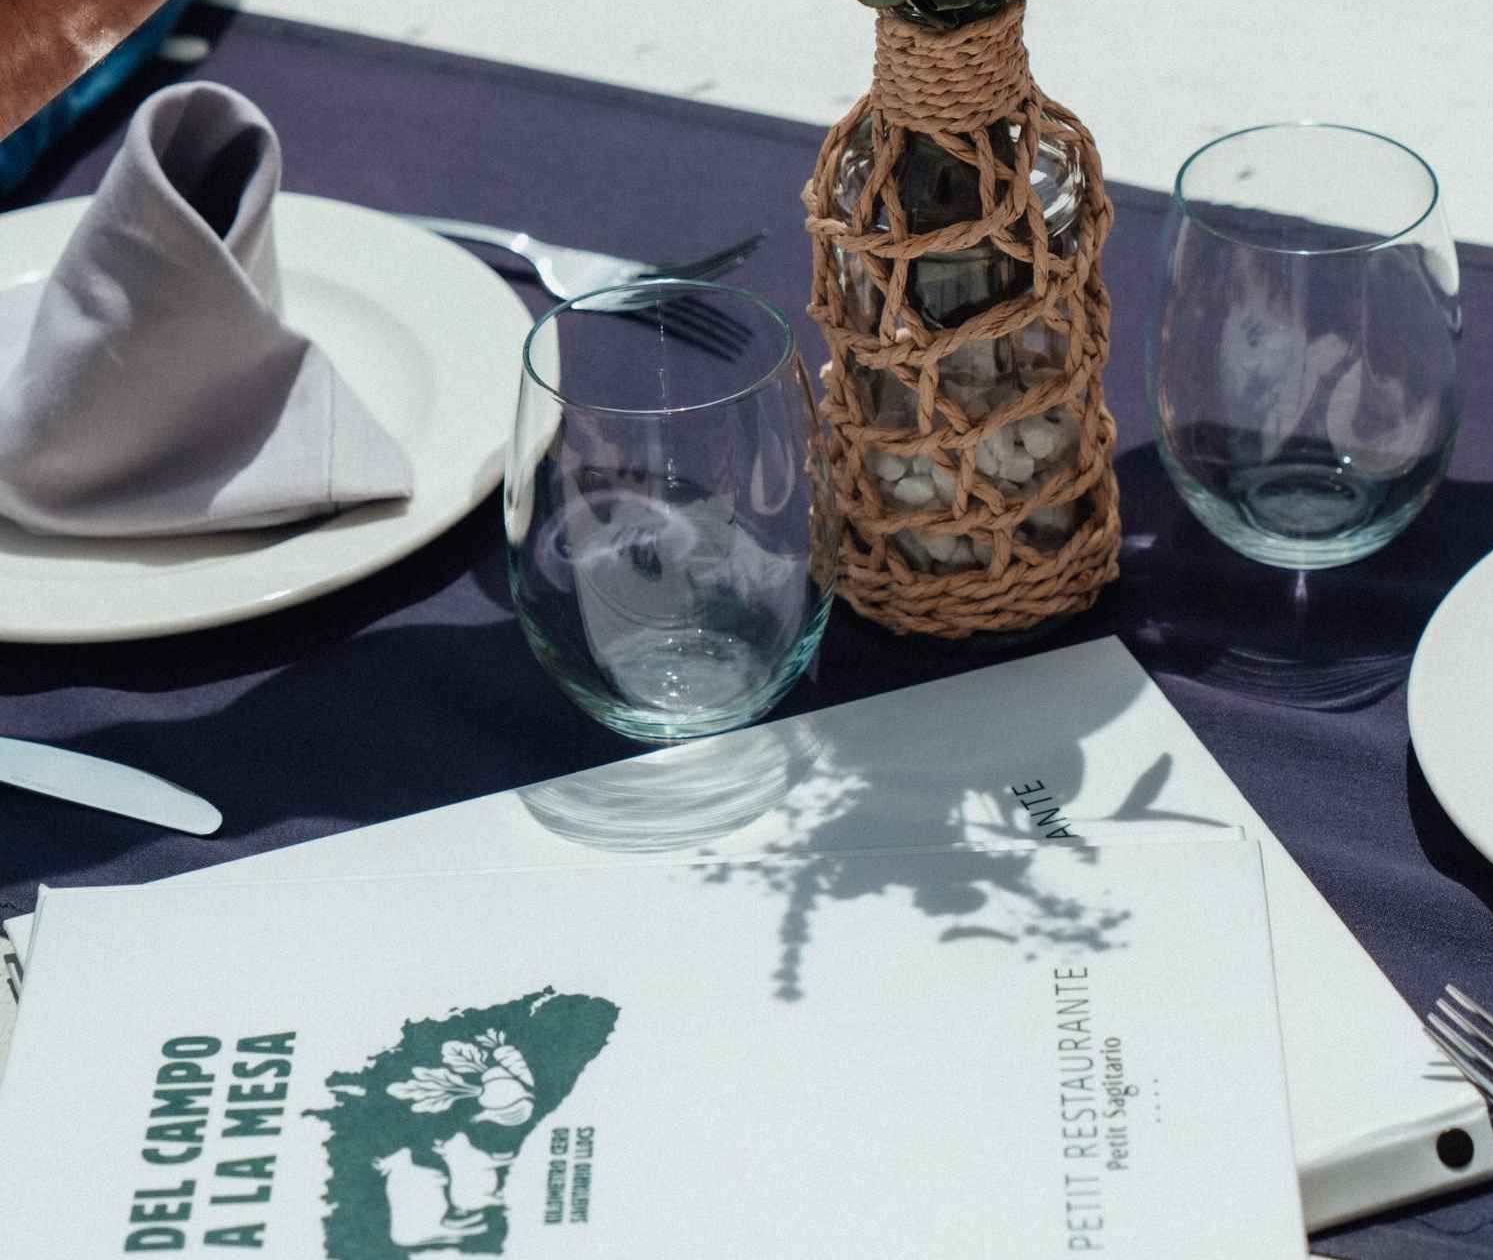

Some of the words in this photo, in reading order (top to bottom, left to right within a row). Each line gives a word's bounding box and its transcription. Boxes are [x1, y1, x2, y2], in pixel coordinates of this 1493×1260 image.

[141, 1035, 223, 1165] CAMPO
[221, 1031, 297, 1139] MESA
[1054, 966, 1099, 1158] RESTAURANTE
[1100, 1036, 1140, 1119] Sagitario
[210, 1155, 277, 1205] LA
[1105, 1126, 1129, 1171] Petit
[124, 1179, 196, 1253] DEL
[203, 1222, 267, 1249] A
[1065, 1174, 1104, 1251] PETIT
